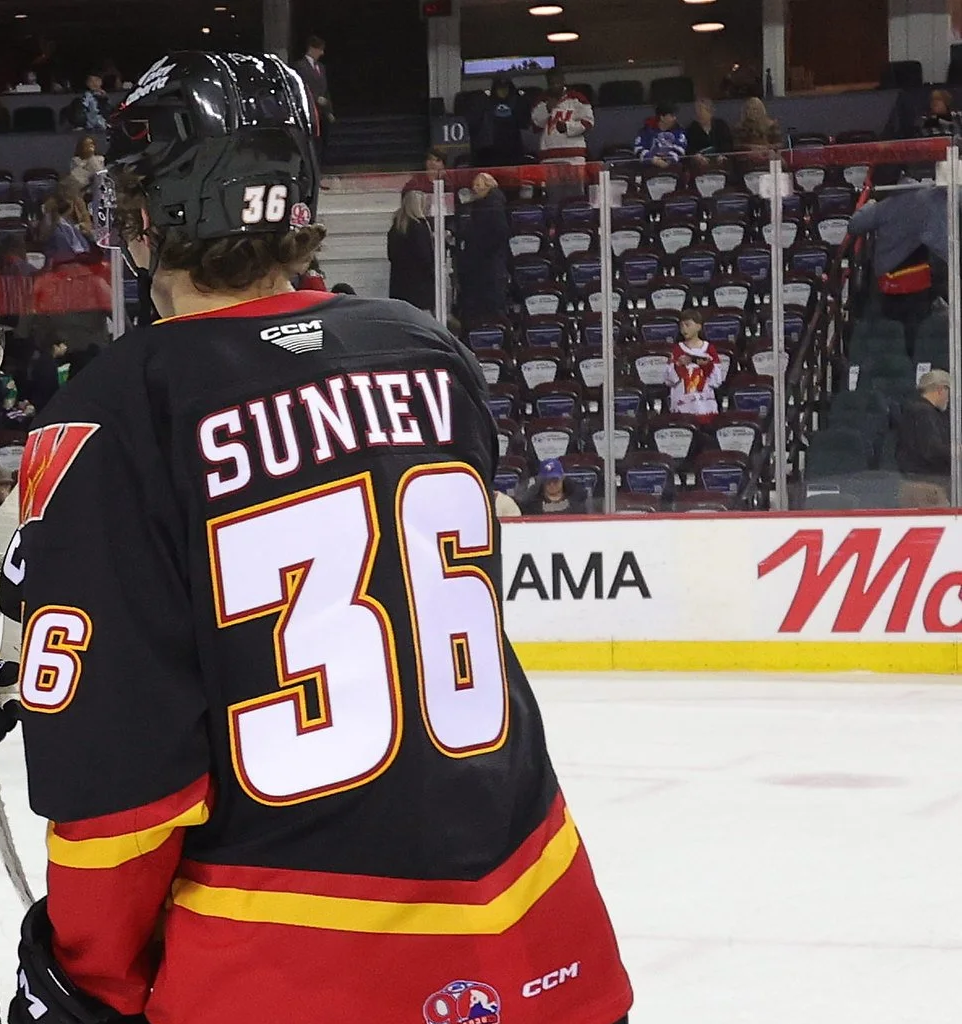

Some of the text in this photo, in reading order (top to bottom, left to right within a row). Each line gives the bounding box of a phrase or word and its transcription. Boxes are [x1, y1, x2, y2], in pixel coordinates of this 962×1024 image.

[442, 122, 464, 142] 10
[241, 185, 288, 223] 36
[260, 319, 323, 341] CCM
[198, 368, 452, 500] SUNIEV
[507, 551, 652, 600] AMA
[206, 461, 510, 808] 36
[19, 604, 93, 714] 6
[522, 962, 580, 998] CCM
